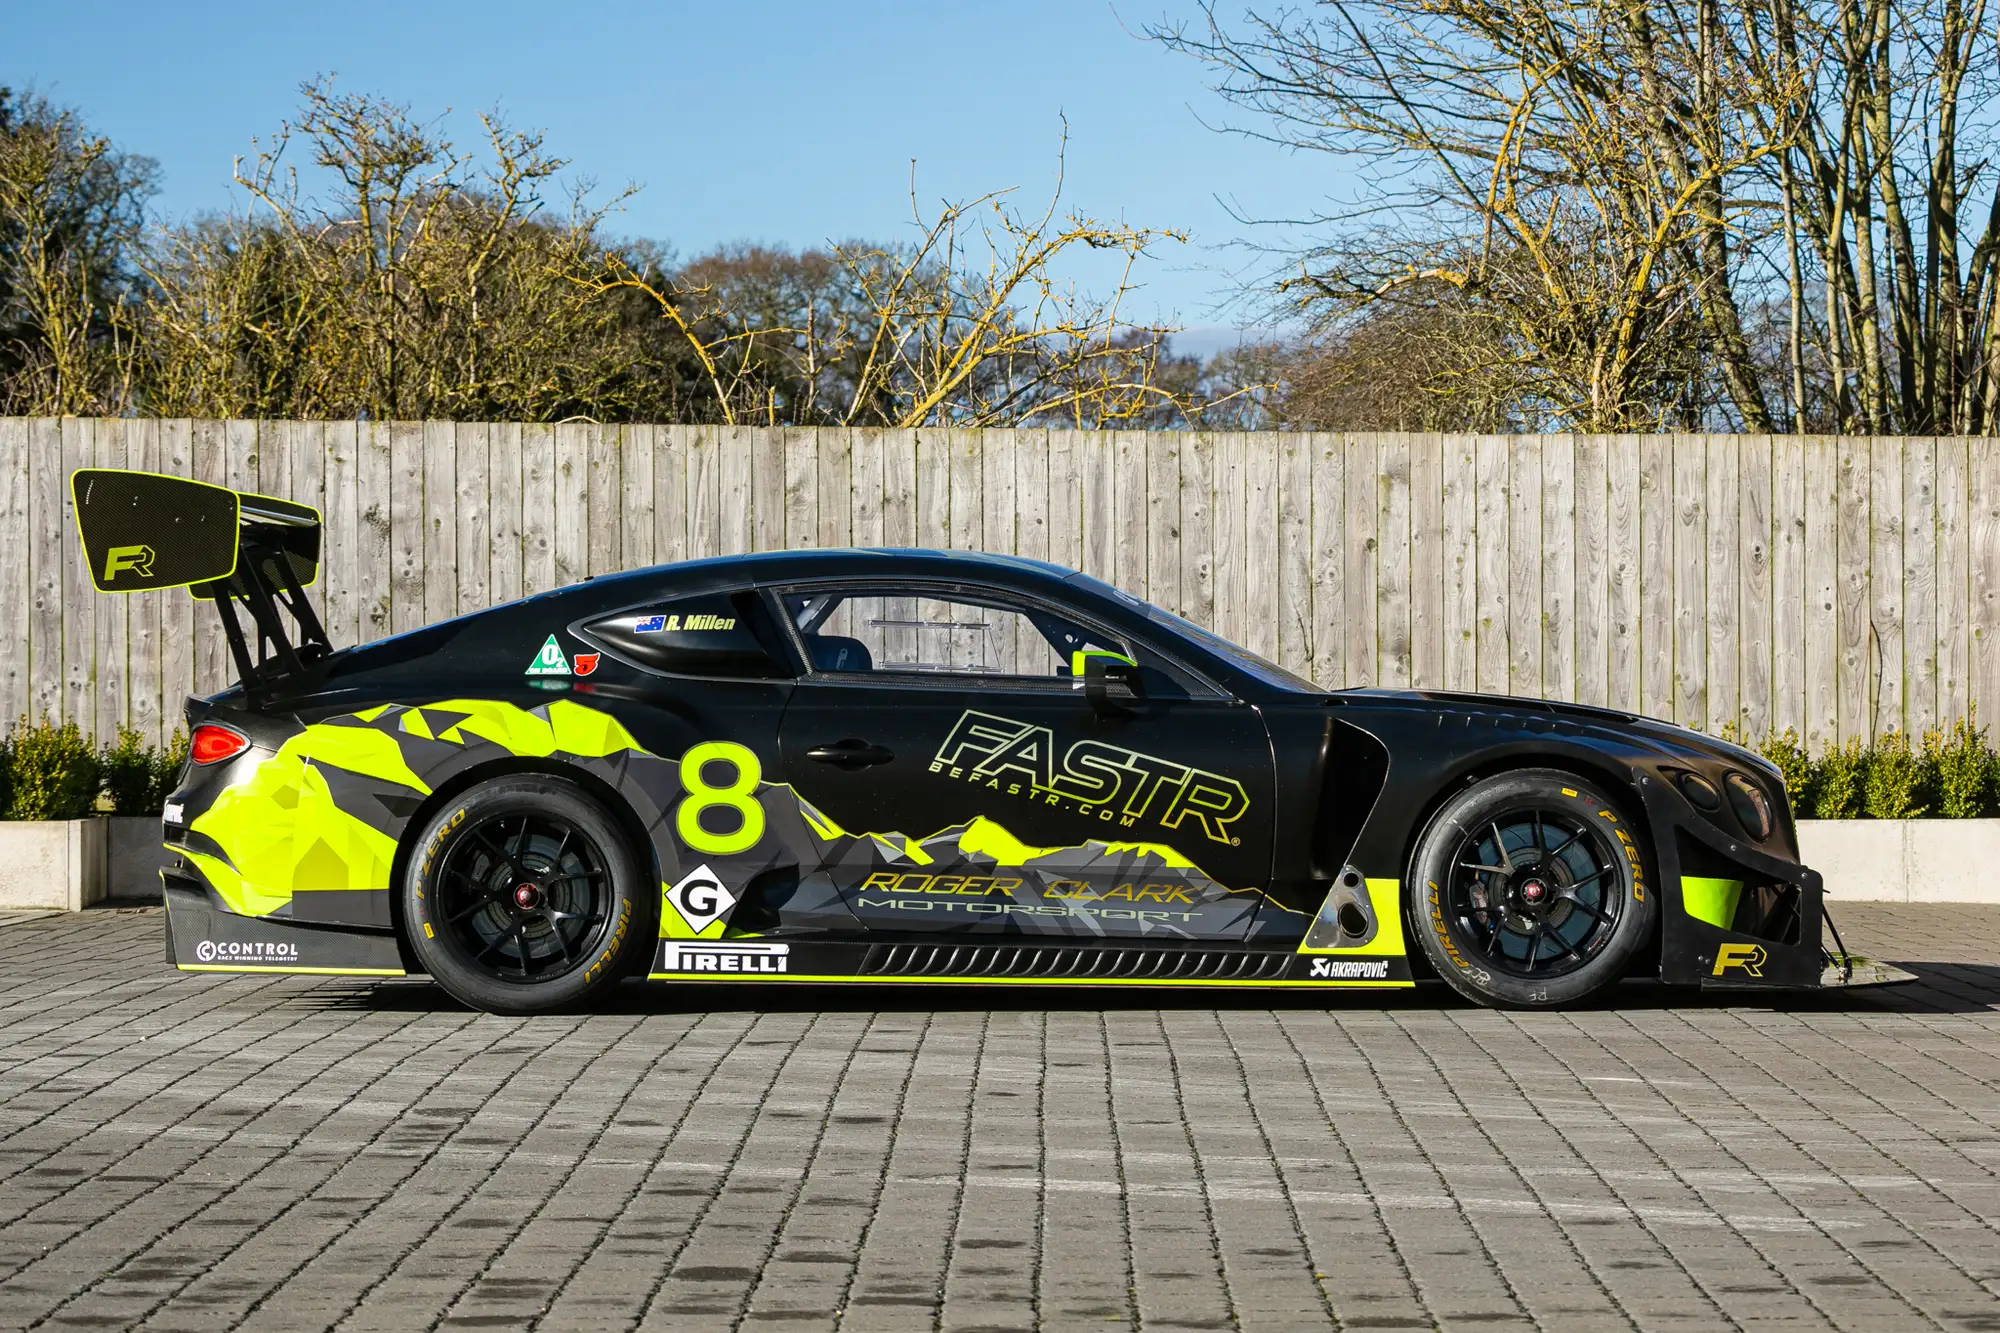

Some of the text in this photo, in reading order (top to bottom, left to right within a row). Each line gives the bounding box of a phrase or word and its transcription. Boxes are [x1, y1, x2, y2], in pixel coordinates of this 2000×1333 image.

[666, 614, 736, 631] R. Millen
[676, 740, 766, 855] 8
[928, 761, 1135, 828] BEFASTR.COM
[416, 808, 465, 900] P ZERO
[1598, 809, 1645, 903] P ZERO
[680, 879, 719, 917] G
[858, 898, 1203, 922] MOTORSPORT
[859, 872, 1200, 904] ROGER CLARK
[217, 942, 298, 956] CONTROL
[583, 897, 632, 985] PIRELLI
[1427, 880, 1470, 968] PIRELLI
[664, 941, 790, 973] PIRELLI
